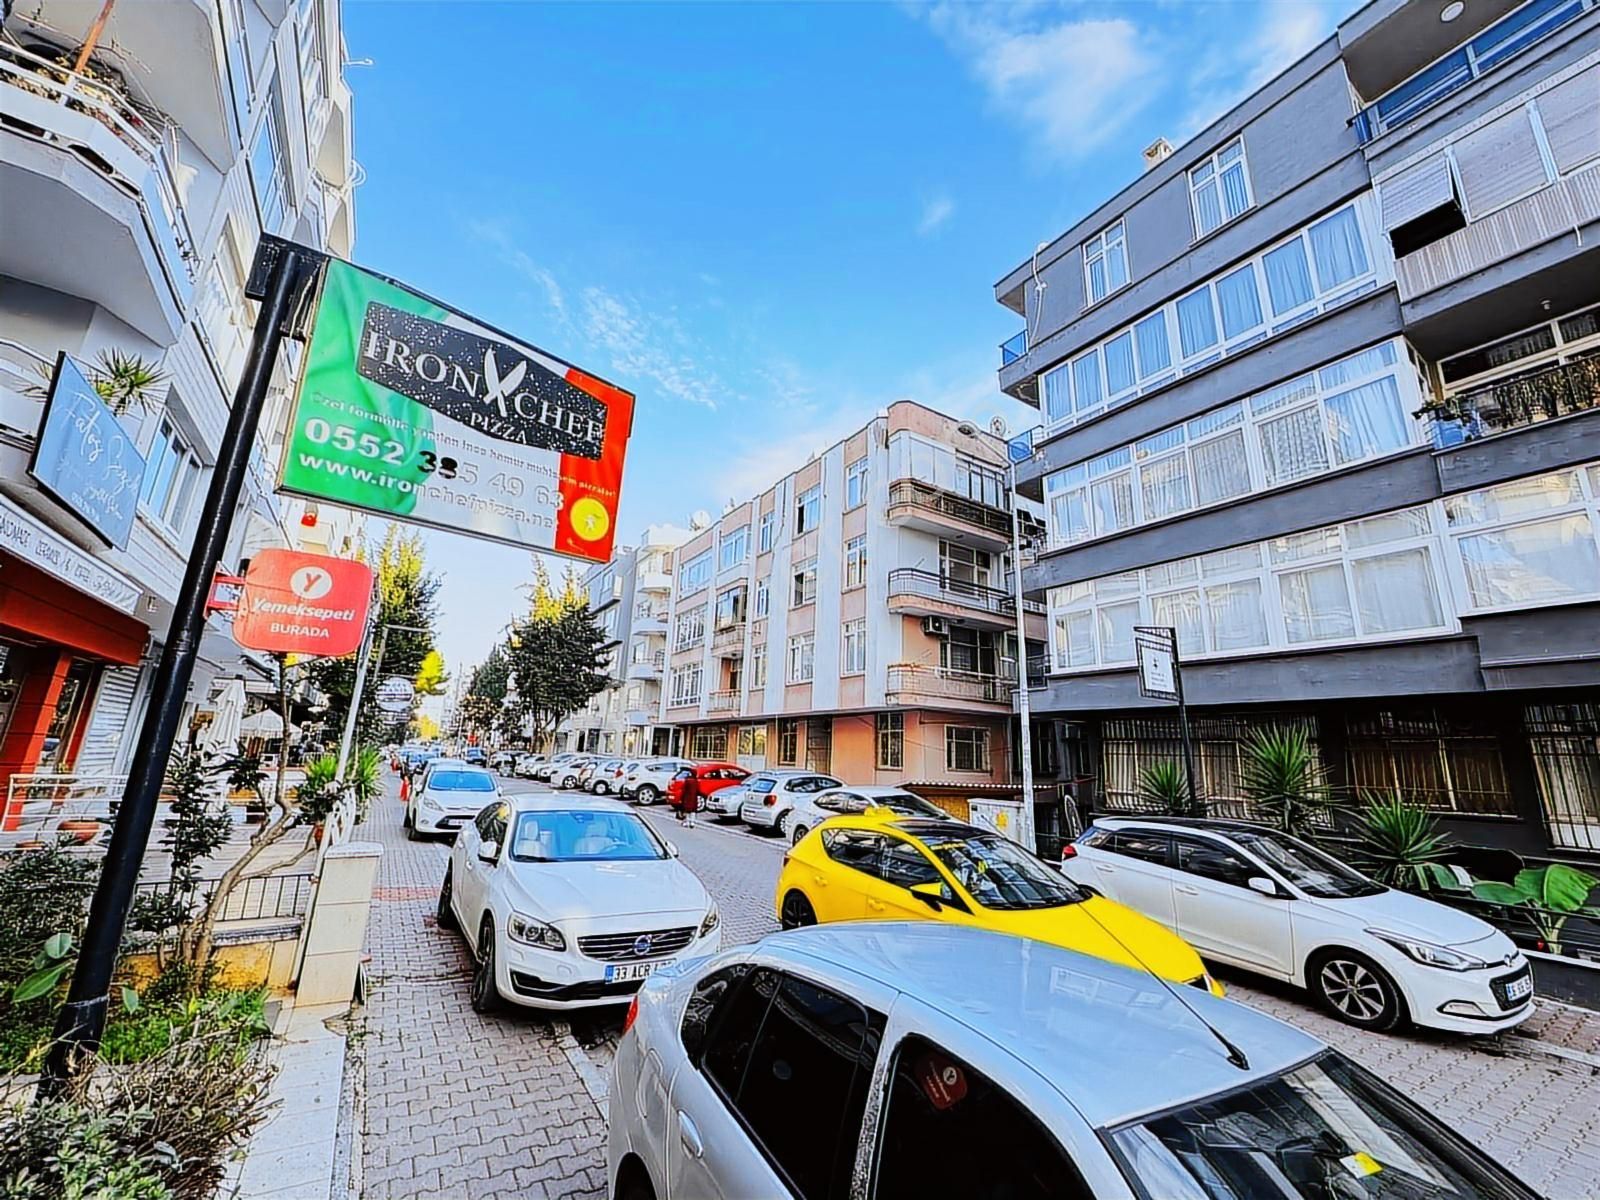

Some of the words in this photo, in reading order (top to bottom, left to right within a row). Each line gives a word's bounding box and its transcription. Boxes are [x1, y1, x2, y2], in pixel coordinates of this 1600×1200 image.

[364, 329, 482, 397] IRON
[514, 391, 604, 442] CHEF
[470, 412, 527, 444] PIZZA
[304, 417, 405, 466] 0552
[486, 470, 524, 497] 49
[253, 597, 355, 621] Yemeksepeti
[268, 621, 330, 639] BURADA
[613, 966, 628, 981] 33
